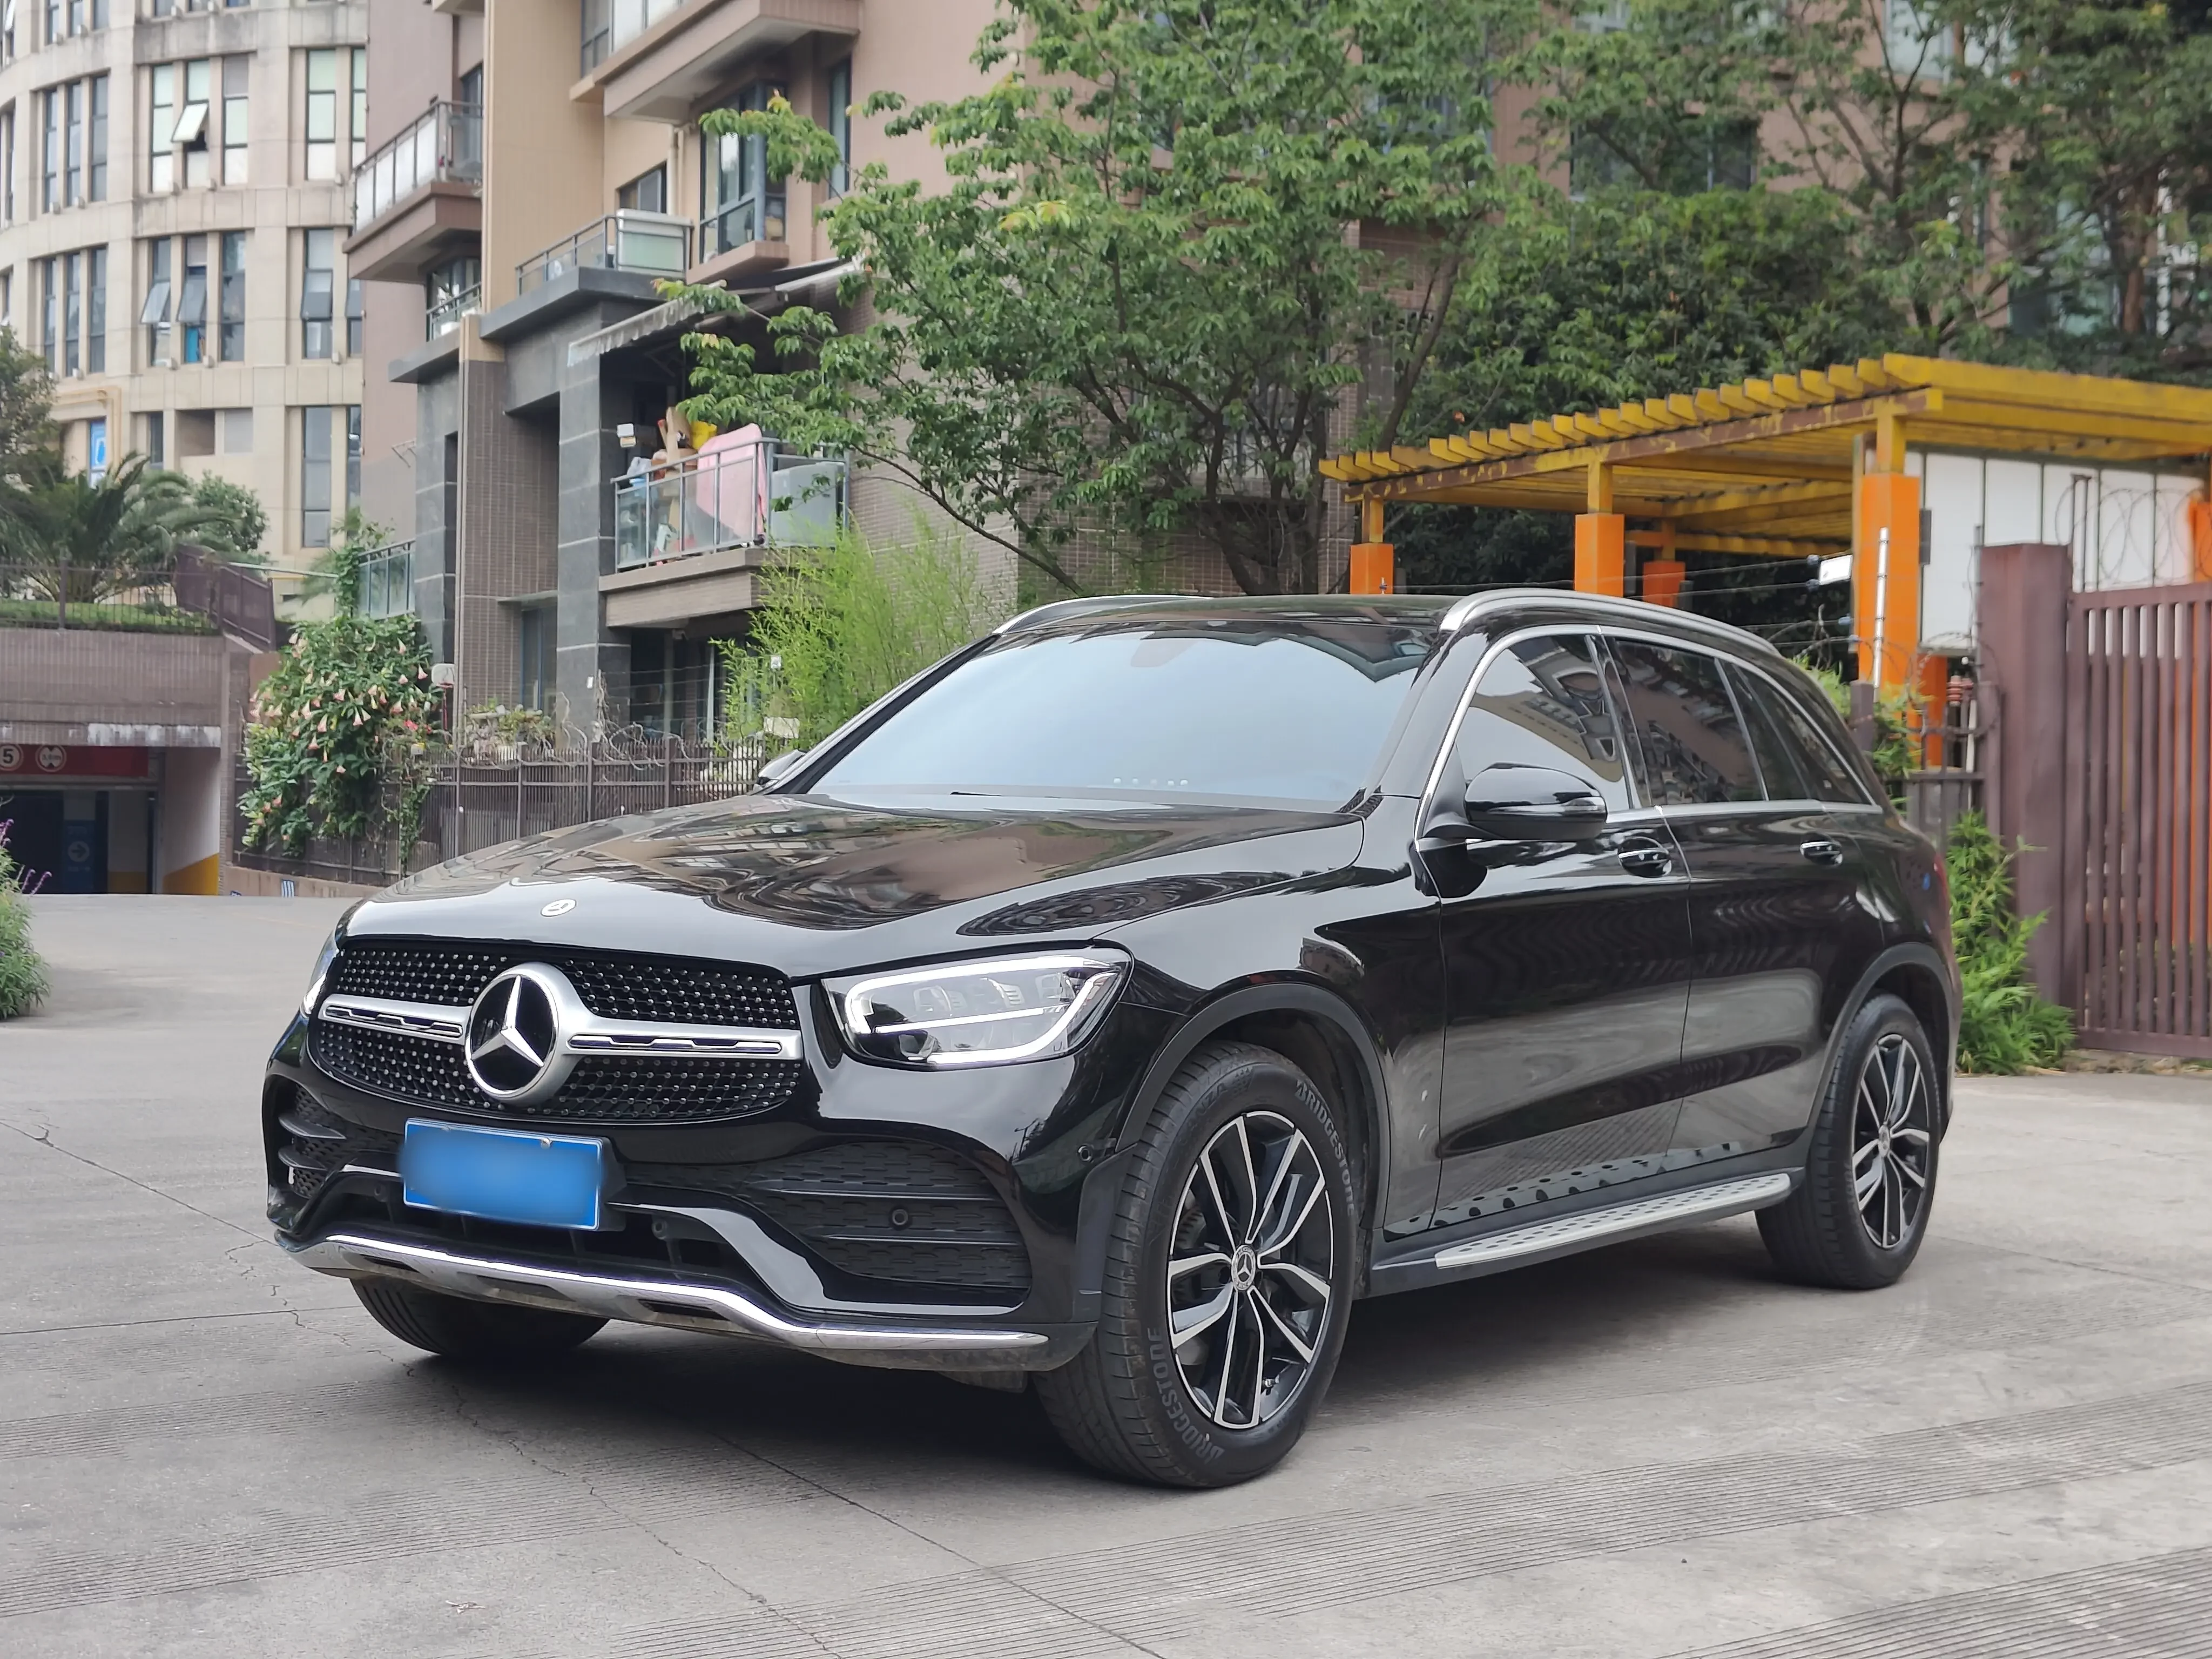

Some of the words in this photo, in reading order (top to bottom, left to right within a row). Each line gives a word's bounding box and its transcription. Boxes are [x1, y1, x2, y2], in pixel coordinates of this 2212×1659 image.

[3, 748, 14, 764] 5
[1294, 1079, 1355, 1217] BRIDGESTONE
[1147, 1327, 1225, 1465] BRIDGESTONE
